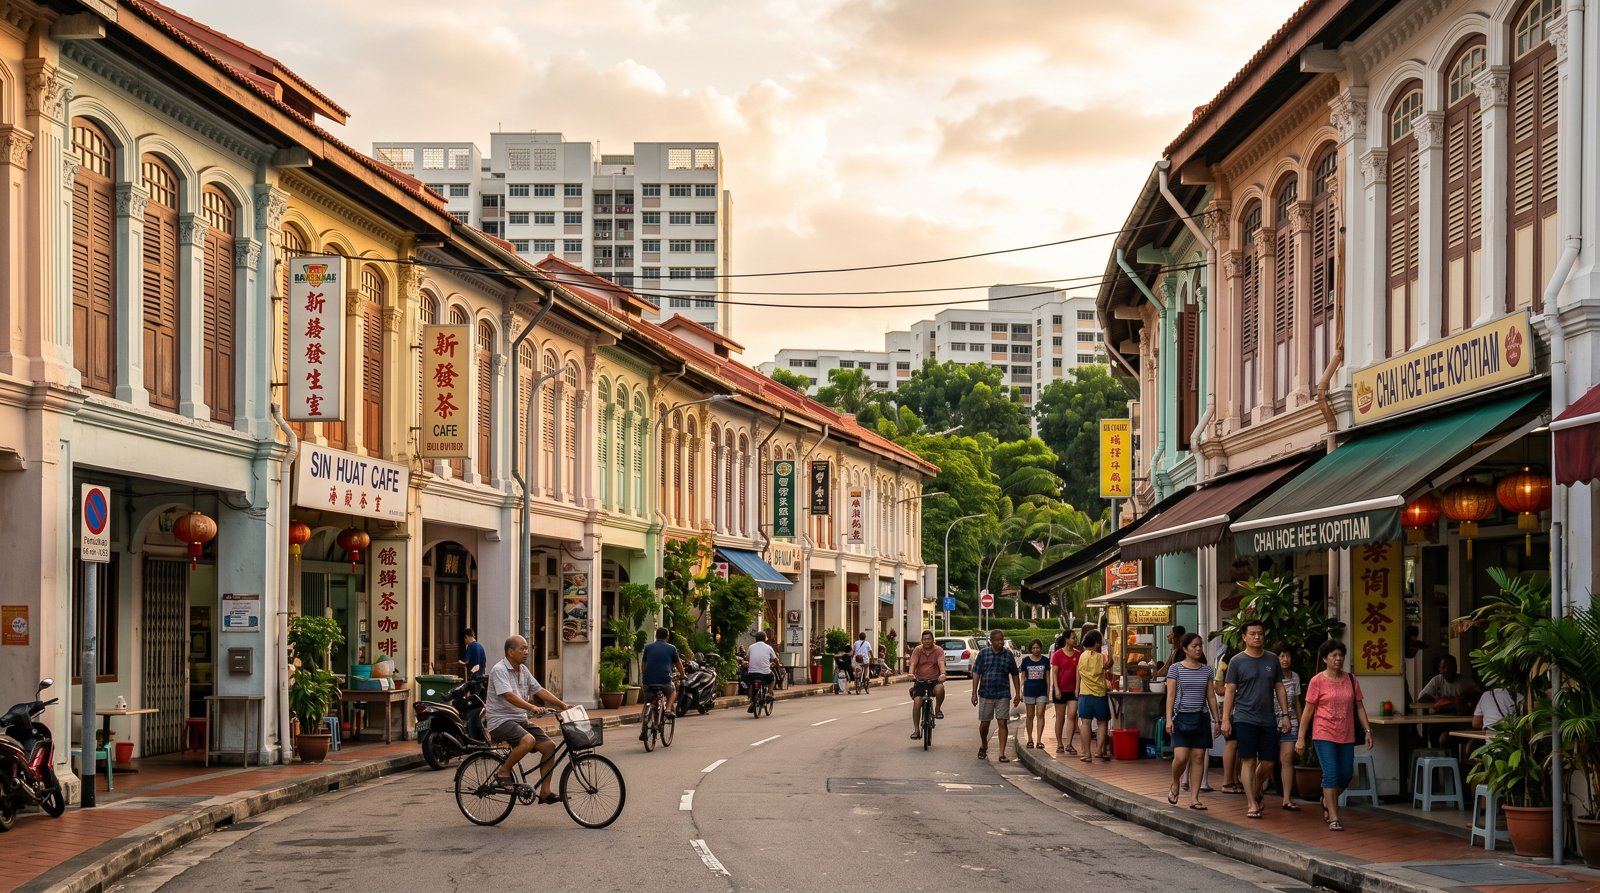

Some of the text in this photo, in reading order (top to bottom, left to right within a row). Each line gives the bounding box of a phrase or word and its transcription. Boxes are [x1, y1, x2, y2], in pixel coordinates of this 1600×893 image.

[433, 332, 459, 419] 新發茶
[1376, 331, 1500, 408] CHAI HOE HEE KOPITIAM
[433, 424, 458, 437] CAFE
[311, 451, 400, 493] SIN HUAT CAFE
[1253, 516, 1370, 552] CHAI HOE HEE KOPITIAM
